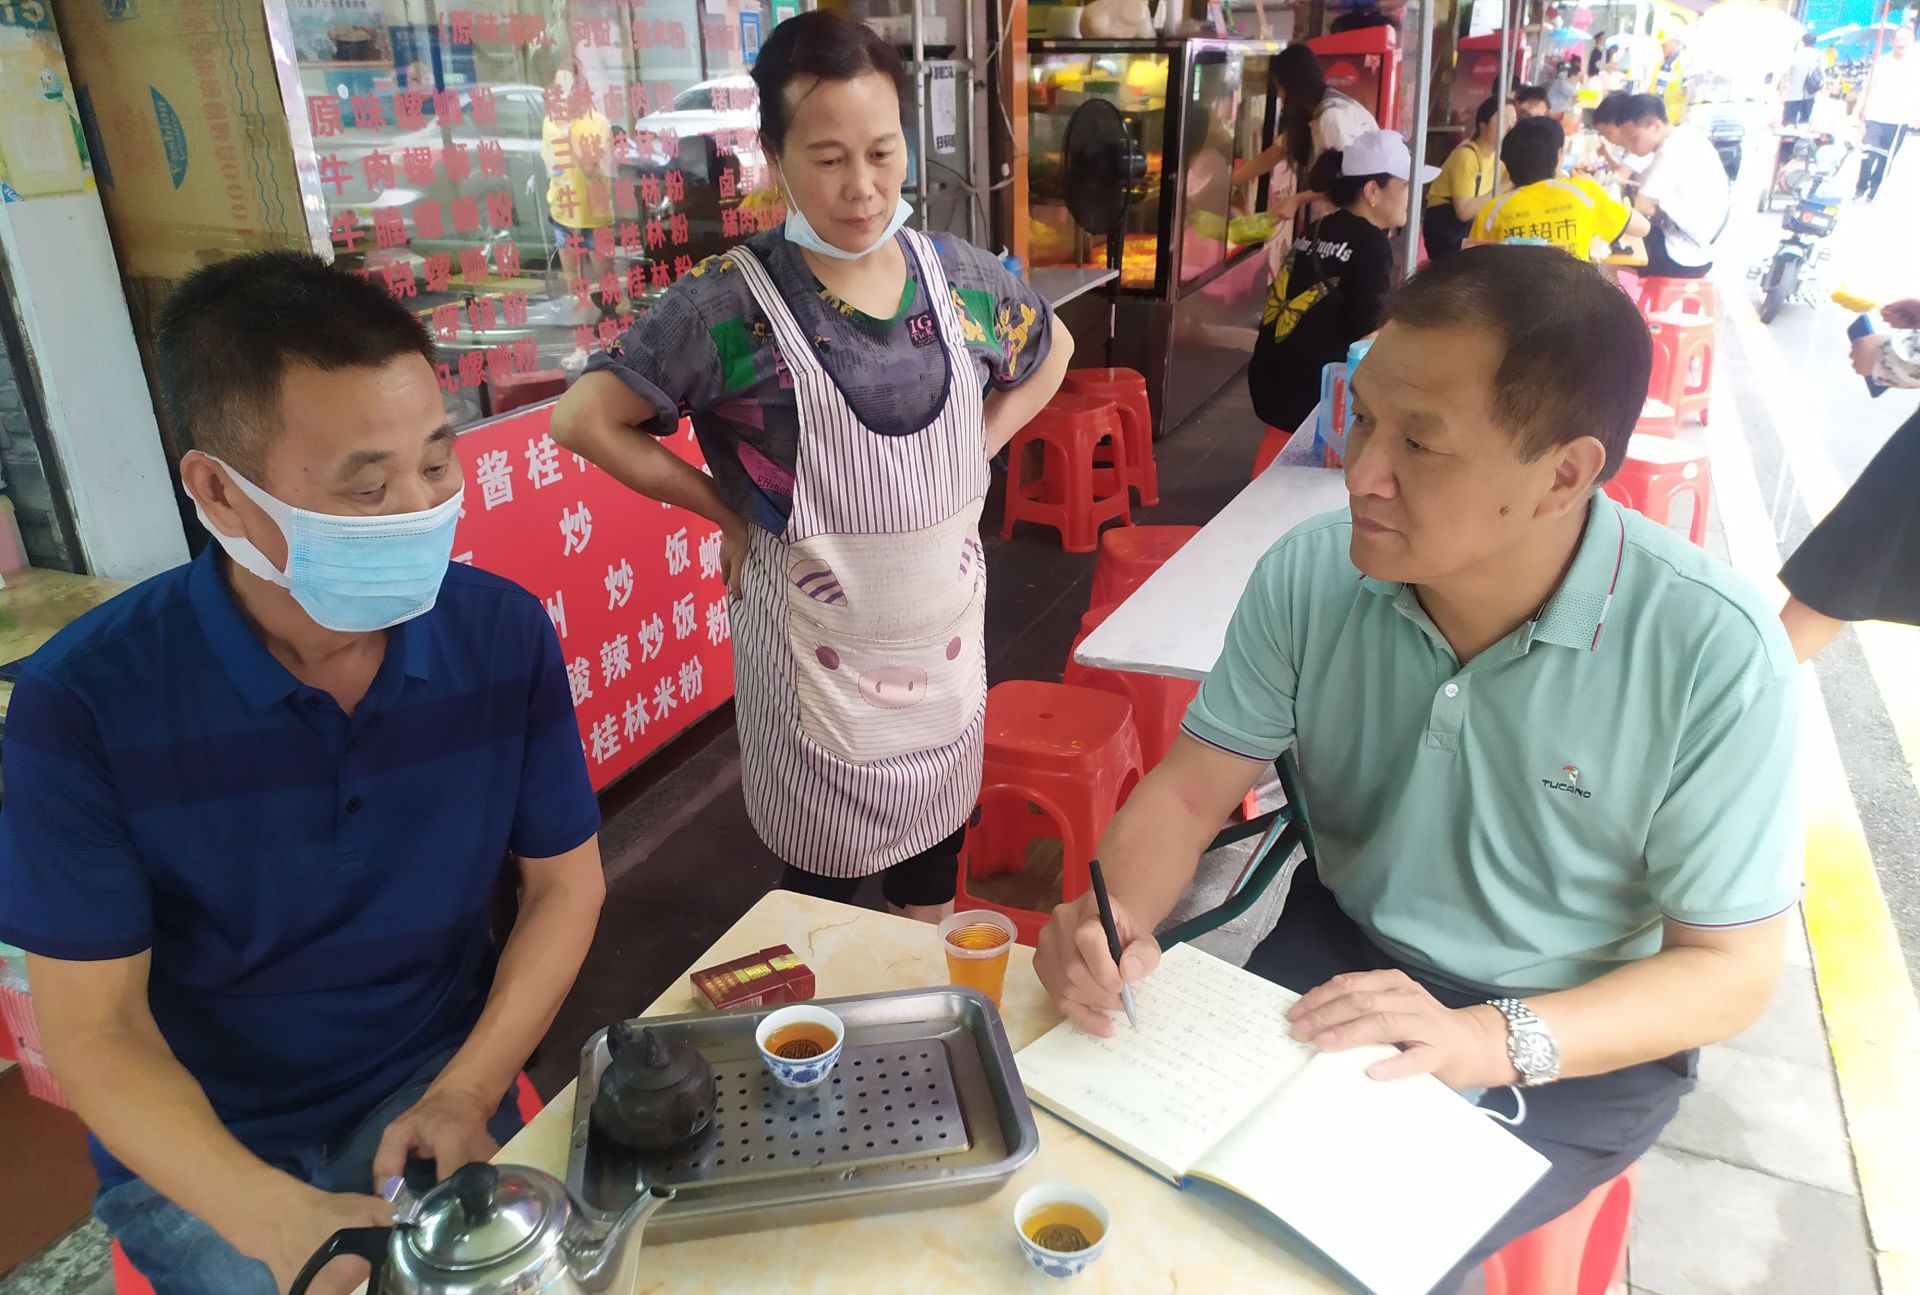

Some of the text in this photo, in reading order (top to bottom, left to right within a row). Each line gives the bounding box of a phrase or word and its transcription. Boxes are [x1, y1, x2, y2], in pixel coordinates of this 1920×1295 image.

[352, 239, 521, 299] 烧螺蛳粉
[414, 290, 528, 341] 螺蛳粉
[589, 654, 704, 765] 桂林米粉
[1542, 778, 1592, 799] TUCANO
